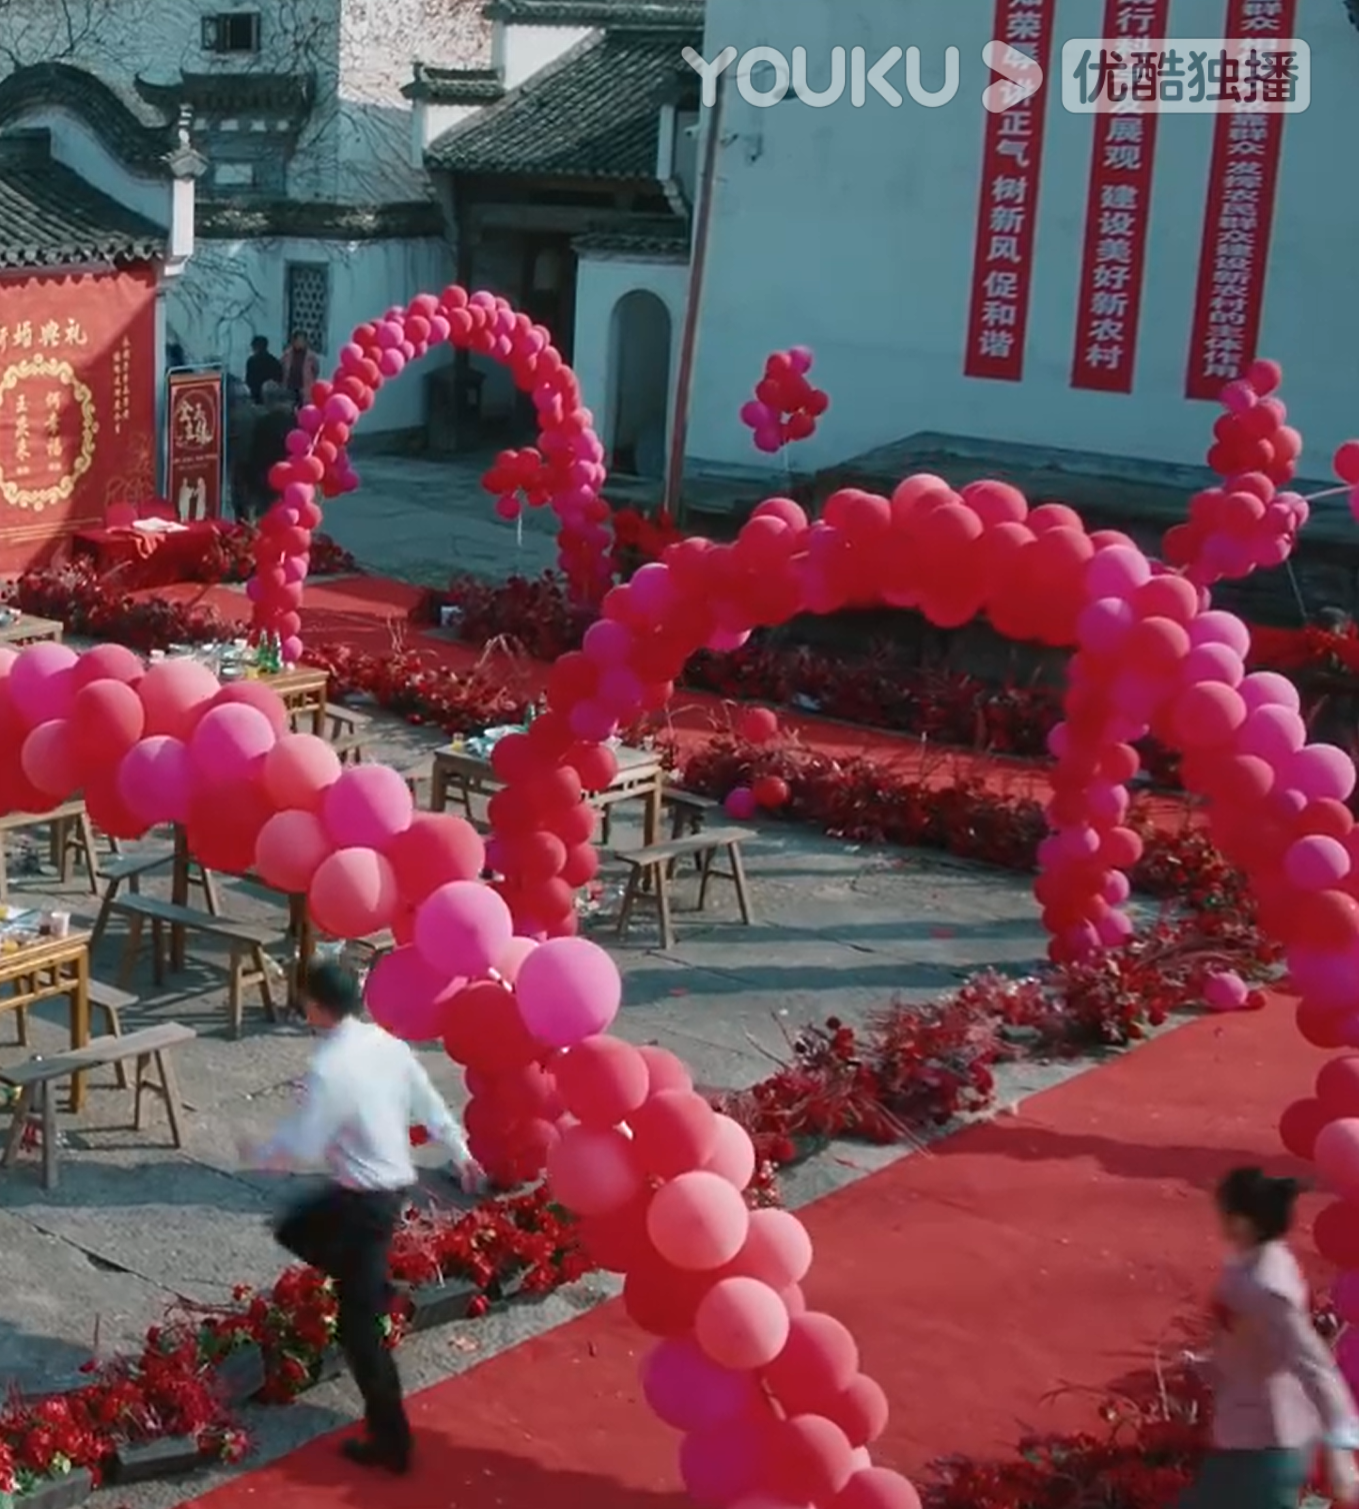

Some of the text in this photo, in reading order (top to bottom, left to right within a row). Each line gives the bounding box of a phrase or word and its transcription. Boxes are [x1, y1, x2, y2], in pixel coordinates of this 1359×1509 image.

[986, 175, 1027, 263] 树新风
[1085, 0, 1156, 369] 行科学发展观 建设美好新农村
[978, 270, 1018, 357] 促和谐
